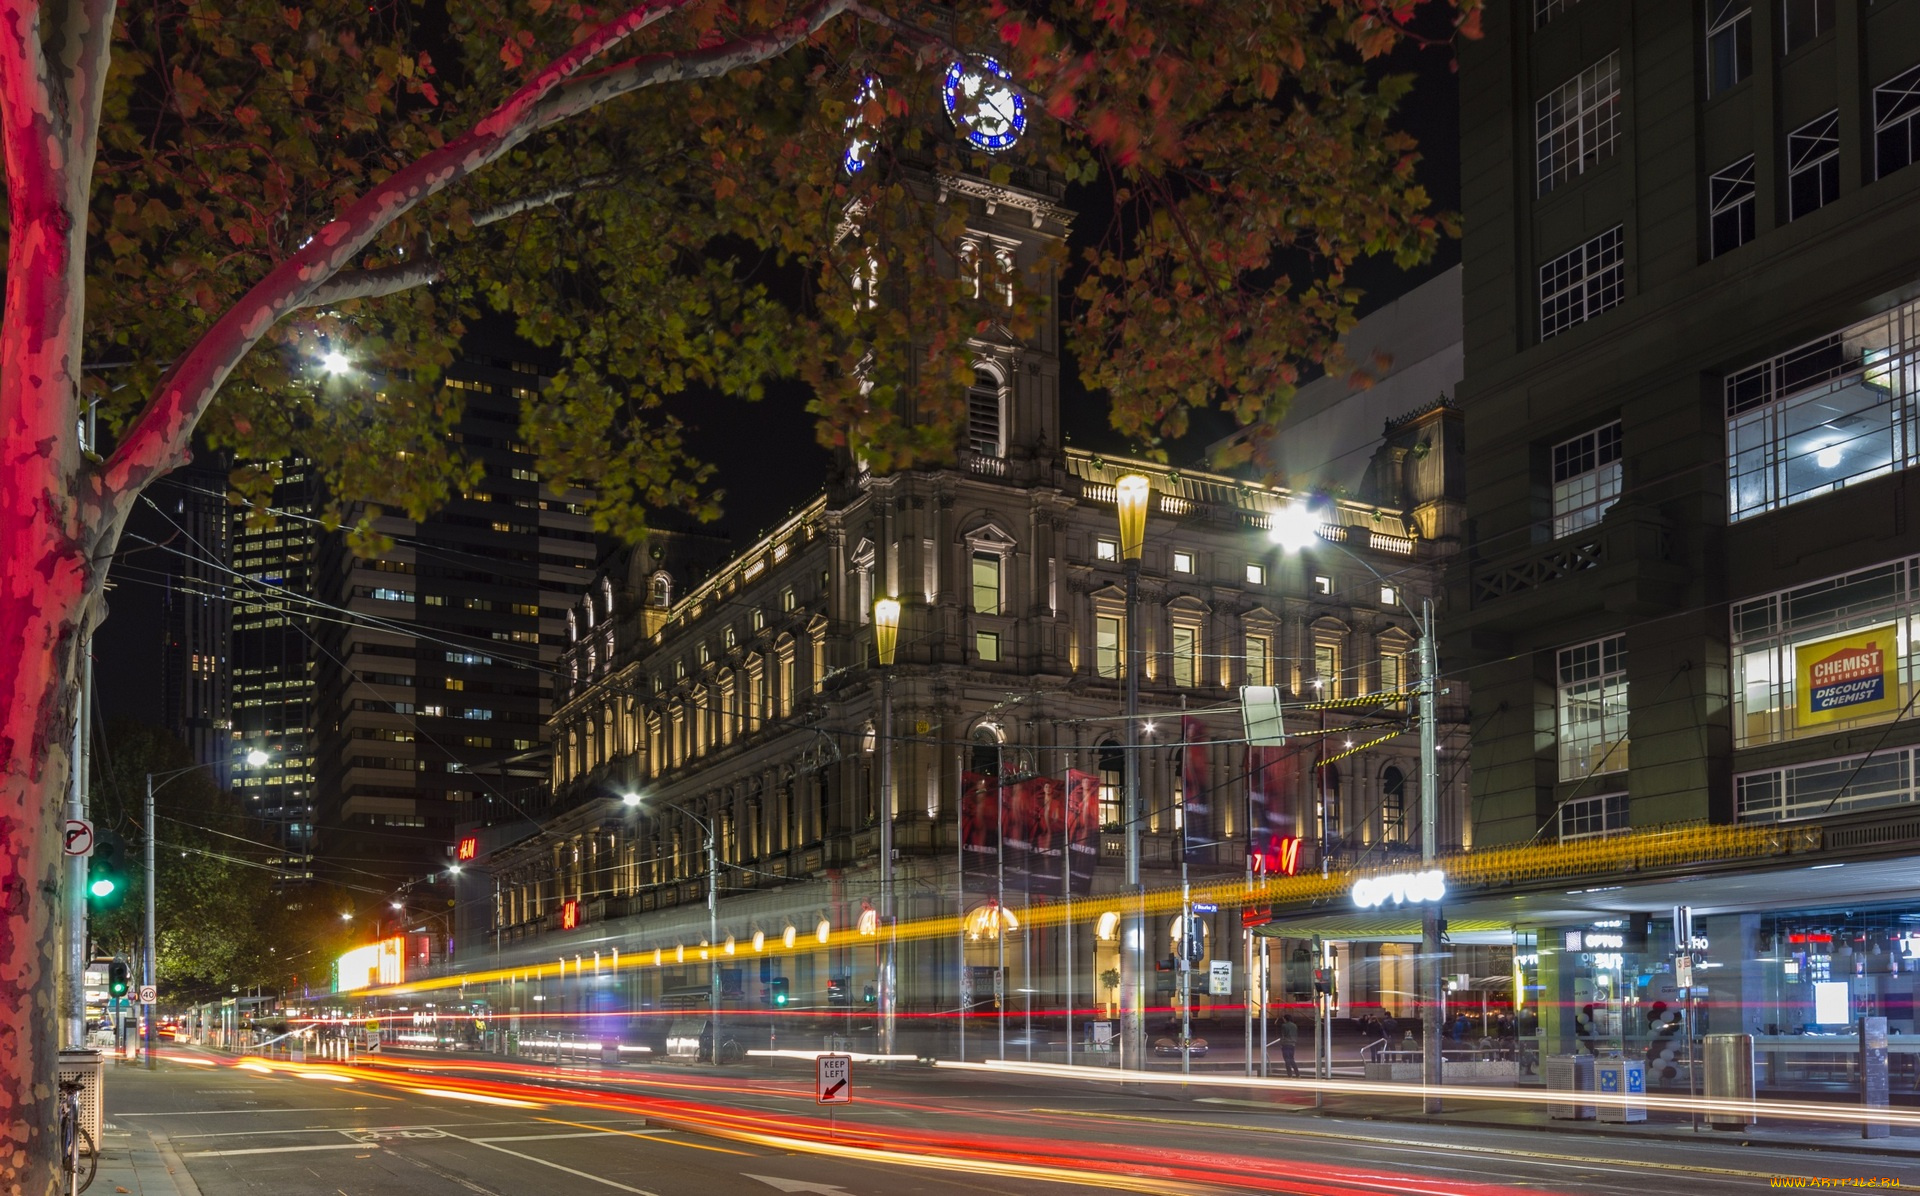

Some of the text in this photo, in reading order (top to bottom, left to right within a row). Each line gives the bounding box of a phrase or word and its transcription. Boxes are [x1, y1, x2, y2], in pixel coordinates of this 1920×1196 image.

[1815, 652, 1878, 677] CHEMIST
[1816, 667, 1880, 685] WAREHOUSE
[1816, 678, 1879, 698] DISCOUNT
[1821, 690, 1875, 707] CHEMIST
[825, 1070, 844, 1078] LEFT
